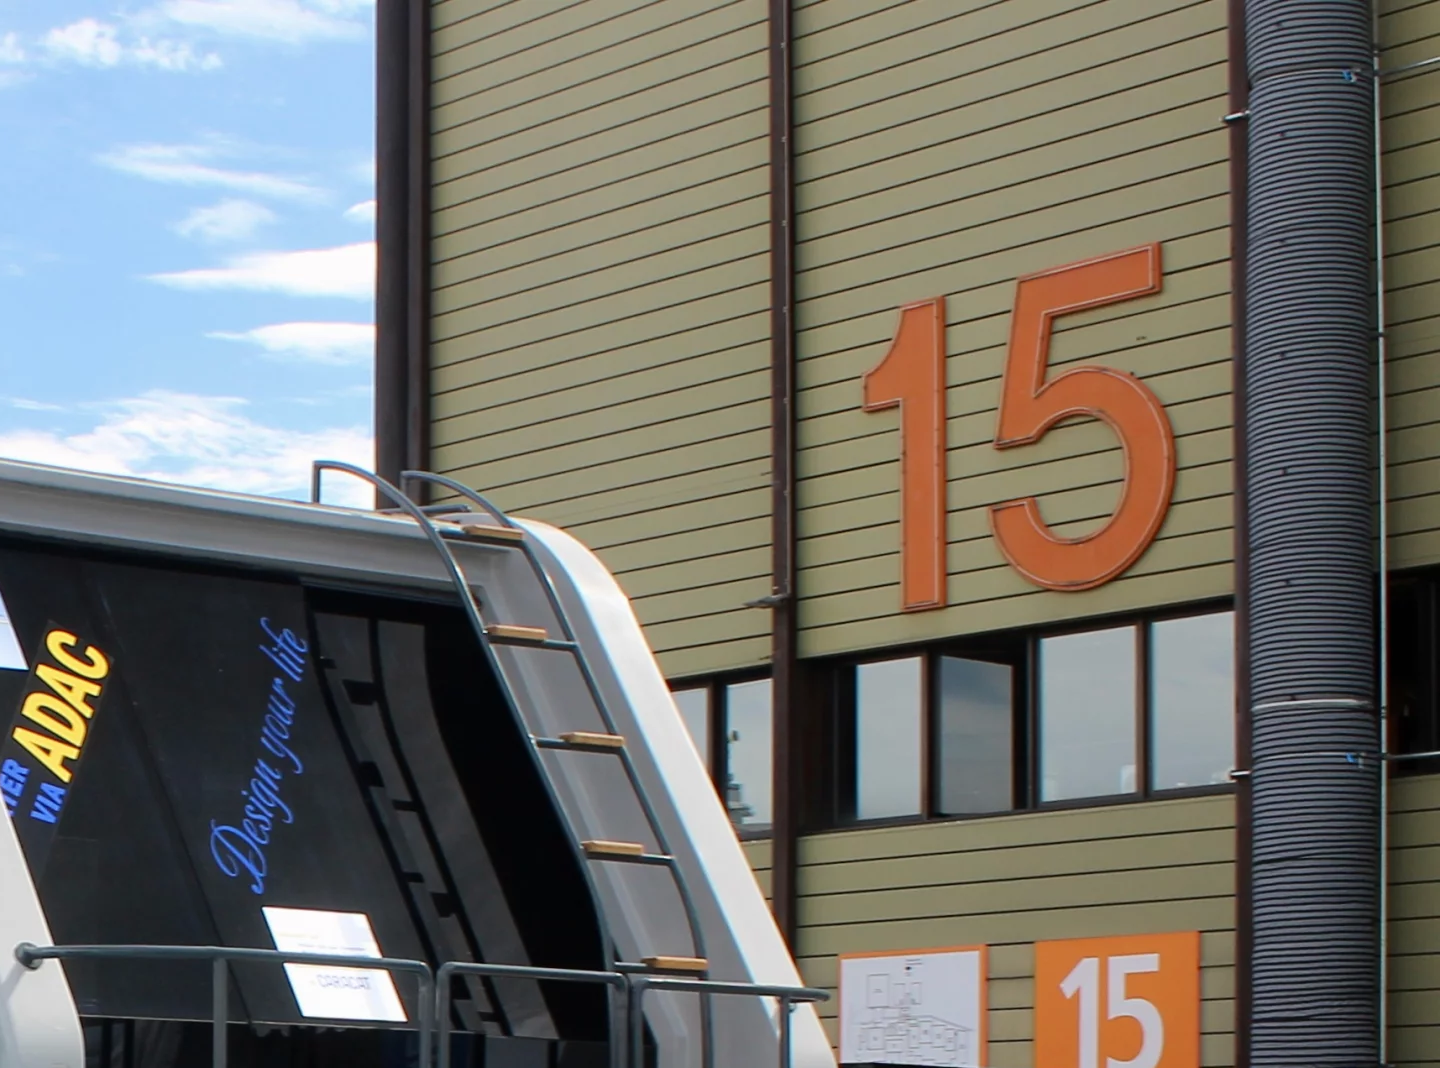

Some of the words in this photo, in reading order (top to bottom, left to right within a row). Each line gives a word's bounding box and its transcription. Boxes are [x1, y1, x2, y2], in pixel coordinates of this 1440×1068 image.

[862, 242, 1177, 613] 15
[12, 629, 110, 784] ADAC
[259, 617, 309, 682] life
[260, 677, 304, 774] your
[30, 782, 66, 824] VIA
[210, 758, 294, 895] Design
